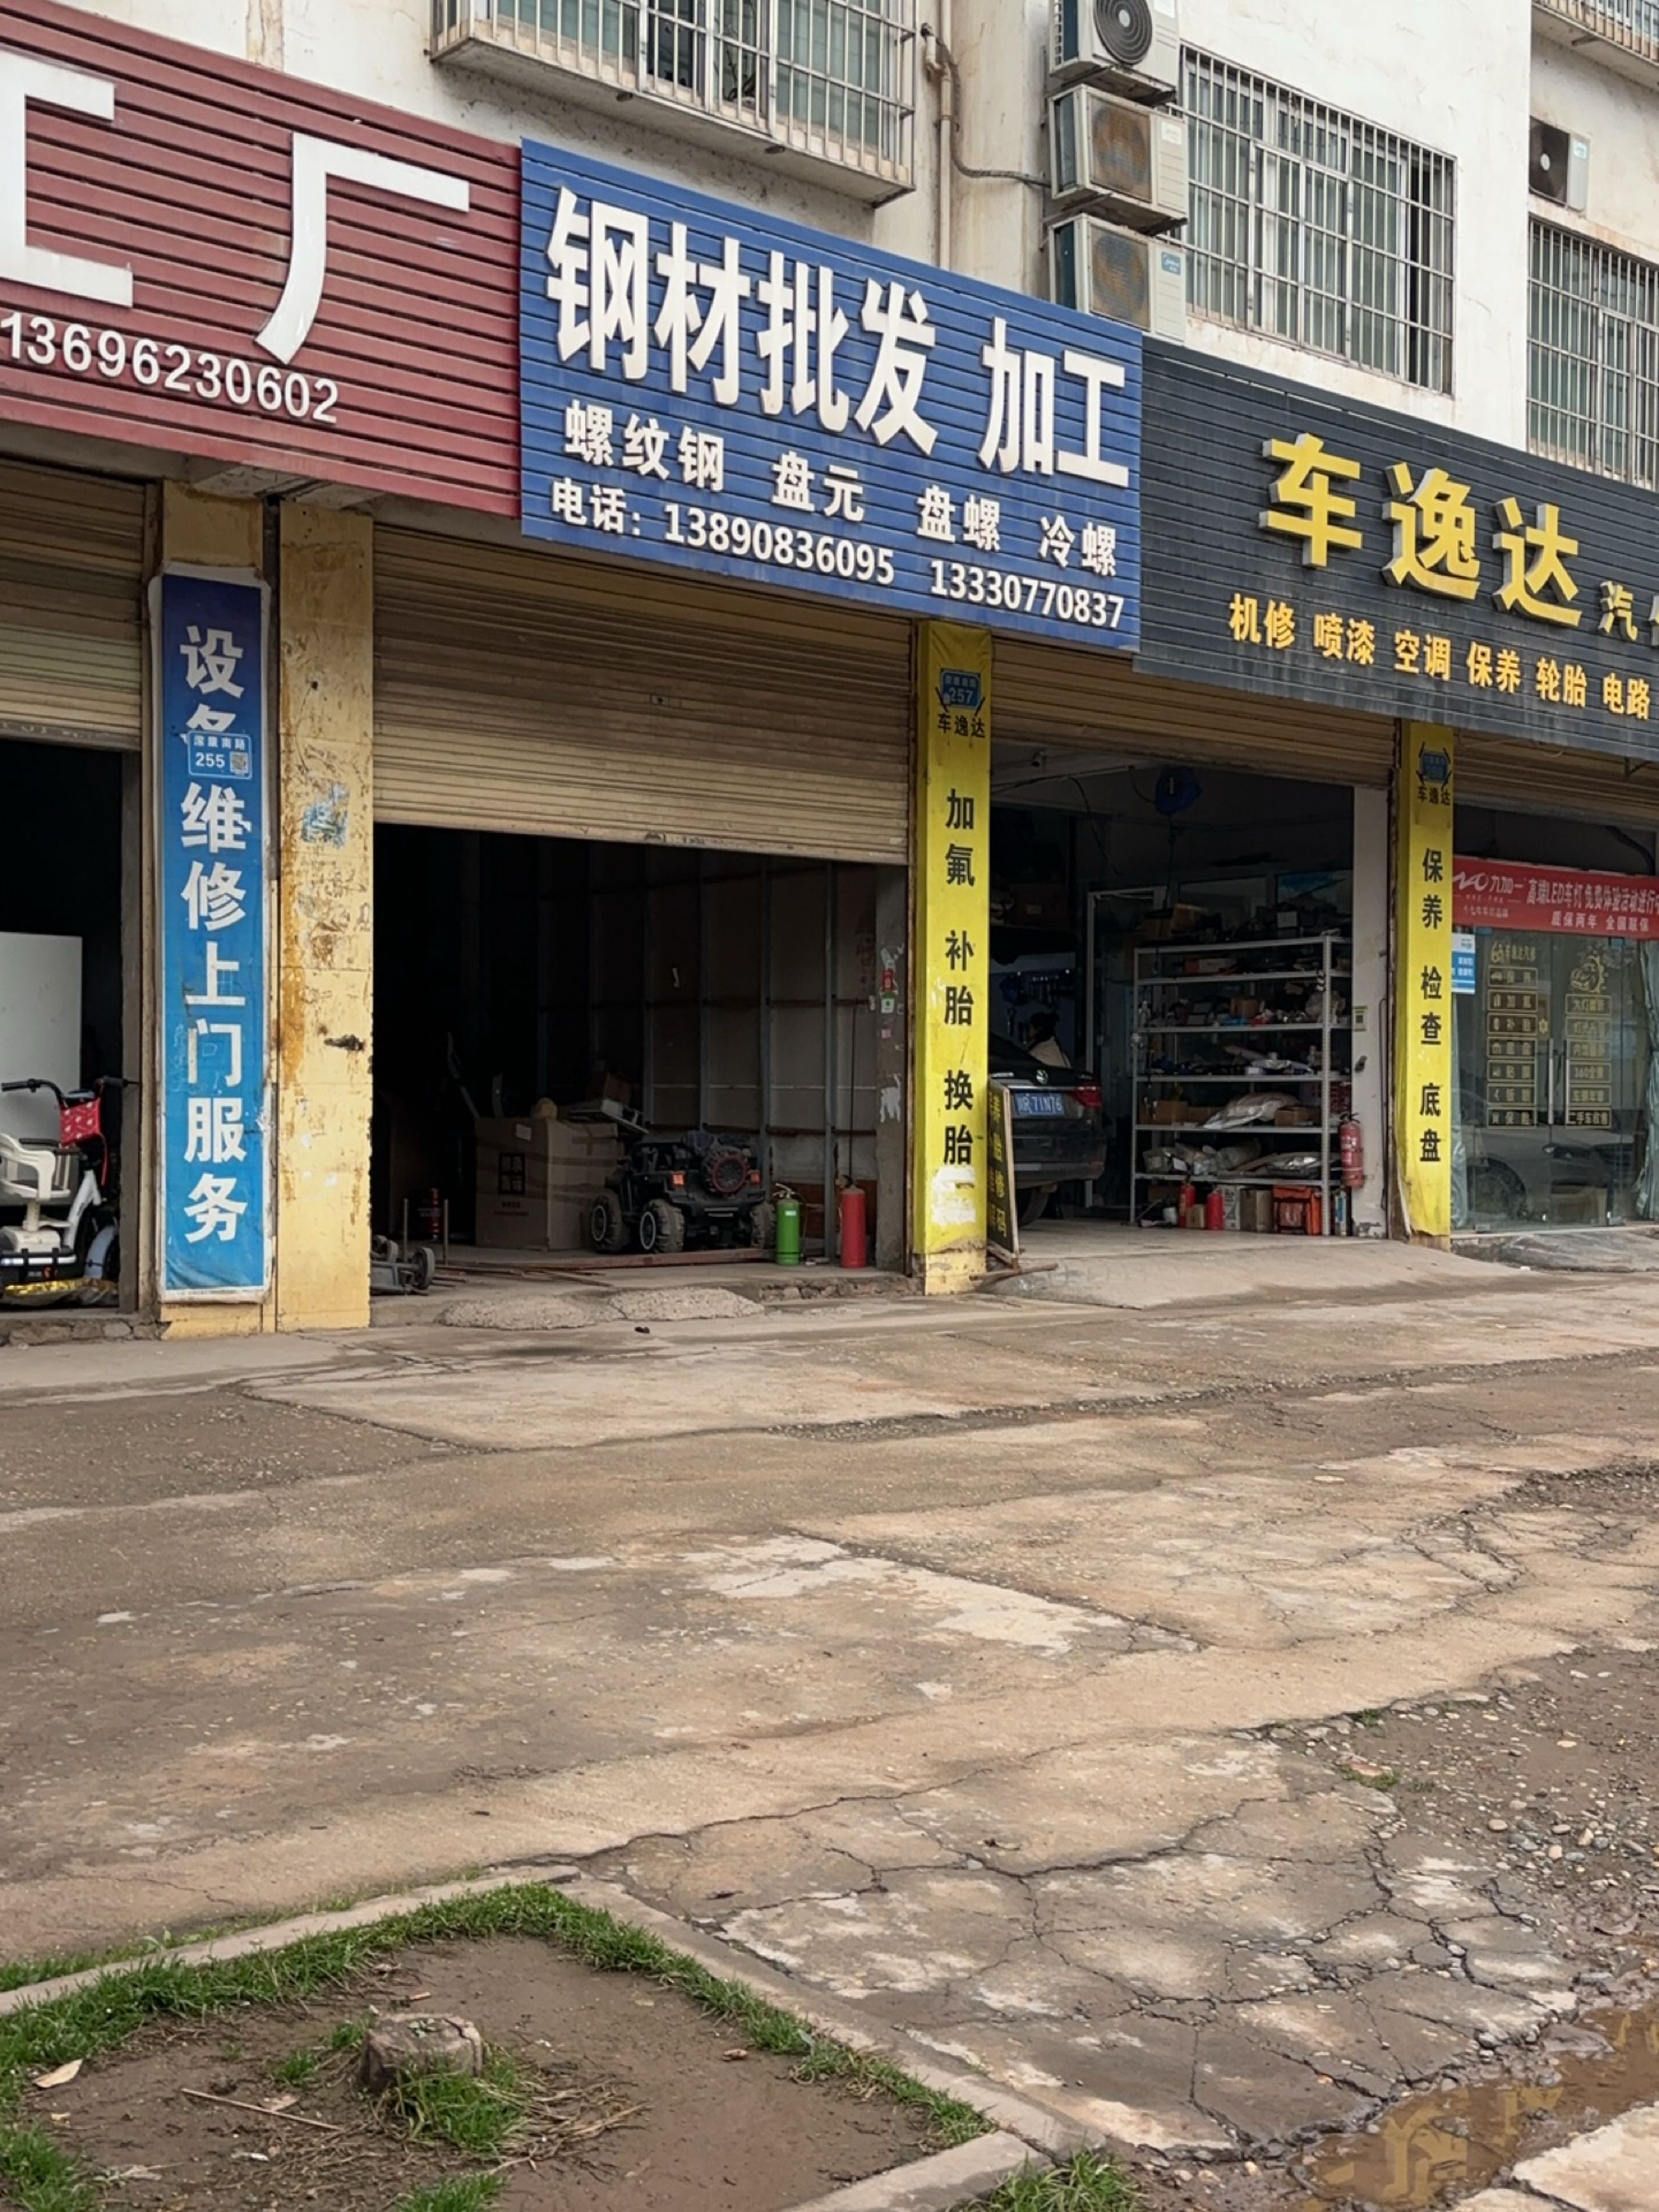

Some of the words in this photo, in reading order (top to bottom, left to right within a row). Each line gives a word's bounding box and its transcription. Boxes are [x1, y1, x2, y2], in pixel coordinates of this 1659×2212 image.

[1, 312, 339, 424] 13696230602
[546, 186, 938, 456] 钢材批发
[978, 317, 1128, 487] 加工
[563, 399, 724, 492] 螺纹钢
[771, 451, 865, 522] 盘元
[916, 485, 1000, 553] 盘螺
[1039, 514, 1117, 578] 冷螺
[1259, 433, 1582, 627] 车逸达
[1598, 580, 1659, 646] 汽
[929, 559, 1124, 630] 13330770837
[949, 687, 973, 704] 257
[1229, 593, 1295, 649] 机修
[1313, 613, 1375, 665] 喷漆
[1394, 629, 1451, 681] 空调
[1467, 641, 1521, 694] 保养
[1535, 657, 1587, 709] 轮胎
[1603, 673, 1651, 720] 电路
[195, 752, 225, 768] 255
[937, 713, 985, 738] 车逸达
[1422, 848, 1443, 929] 保养
[945, 930, 975, 1025] 补胎
[1420, 966, 1442, 1045] 检查
[943, 1070, 974, 1165] 换胎
[1420, 1082, 1441, 1162] 底盘
